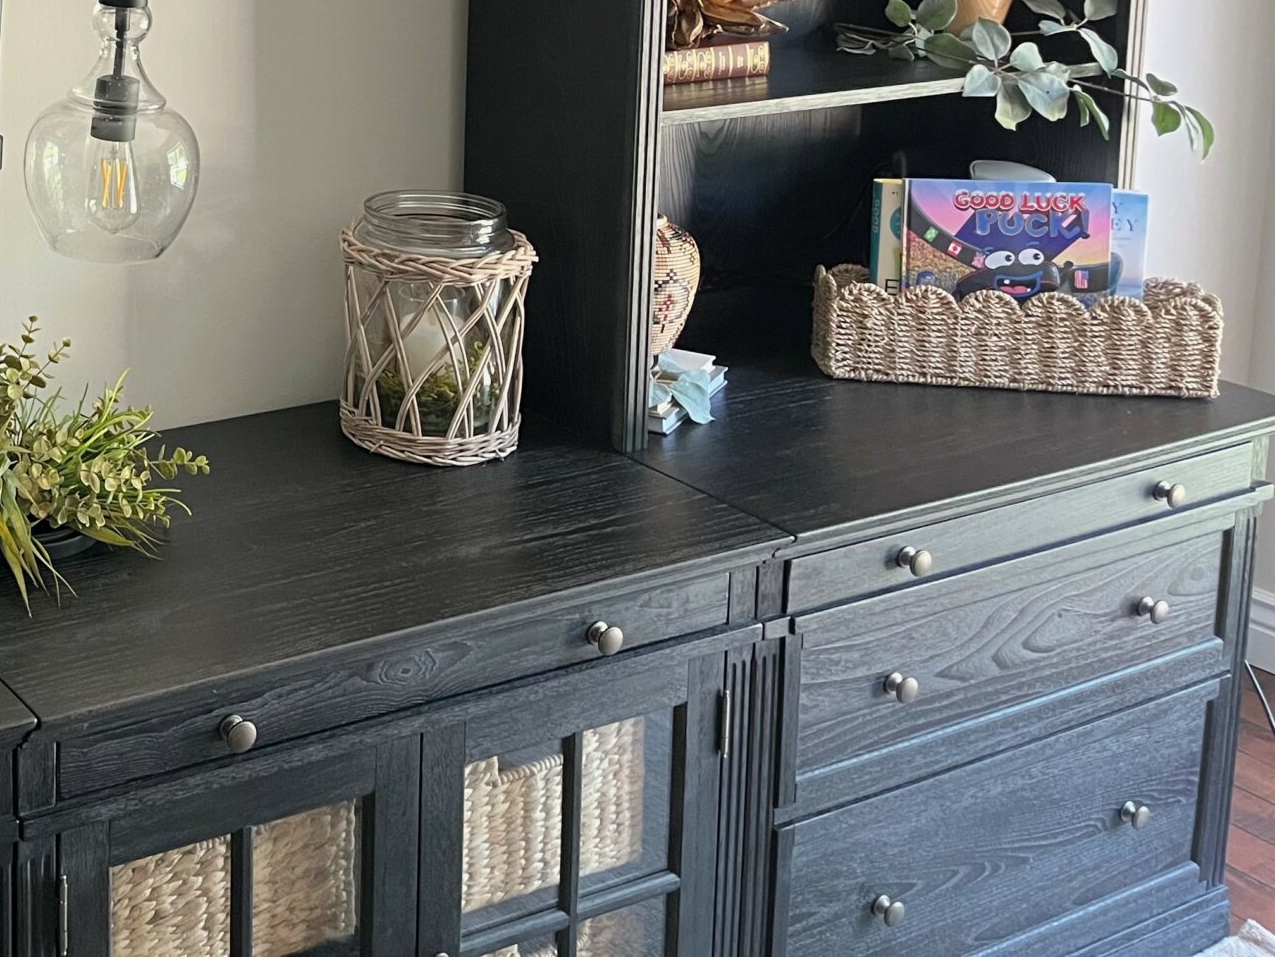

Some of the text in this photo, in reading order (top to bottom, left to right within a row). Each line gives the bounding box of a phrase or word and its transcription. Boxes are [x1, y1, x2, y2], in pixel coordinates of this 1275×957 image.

[953, 189, 1086, 213] GOOD LUCK
[975, 209, 1090, 240] PUCK!
